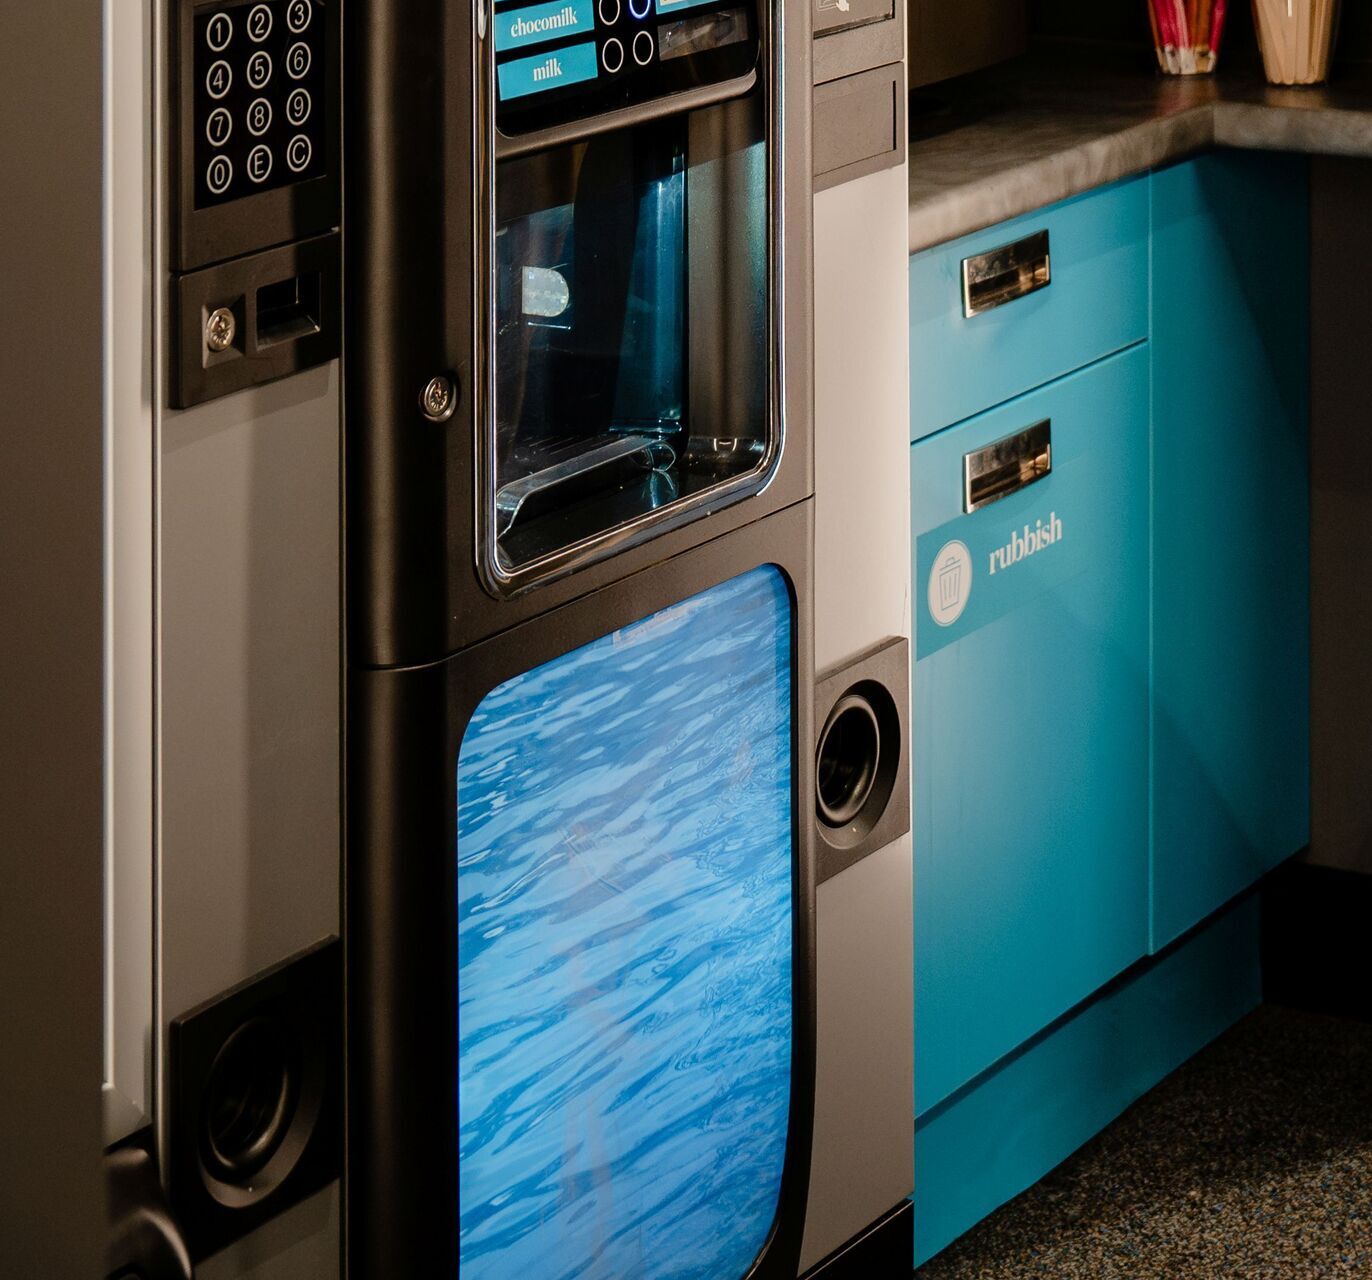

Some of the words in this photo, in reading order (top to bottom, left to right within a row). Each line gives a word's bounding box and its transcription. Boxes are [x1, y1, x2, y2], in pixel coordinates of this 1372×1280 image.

[215, 21, 221, 43] 1
[254, 12, 265, 35] 2
[294, 3, 305, 26] 3
[510, 7, 578, 38] chocomilk
[212, 68, 224, 90] 4
[254, 58, 265, 81] 5
[294, 49, 304, 71] 6
[532, 57, 562, 82] milk
[214, 116, 224, 138] 7
[254, 105, 265, 128] 8
[294, 95, 304, 118] 9
[214, 163, 225, 186] 0
[254, 151, 264, 175] E
[292, 141, 306, 165] C
[989, 511, 1063, 575] rubbish
